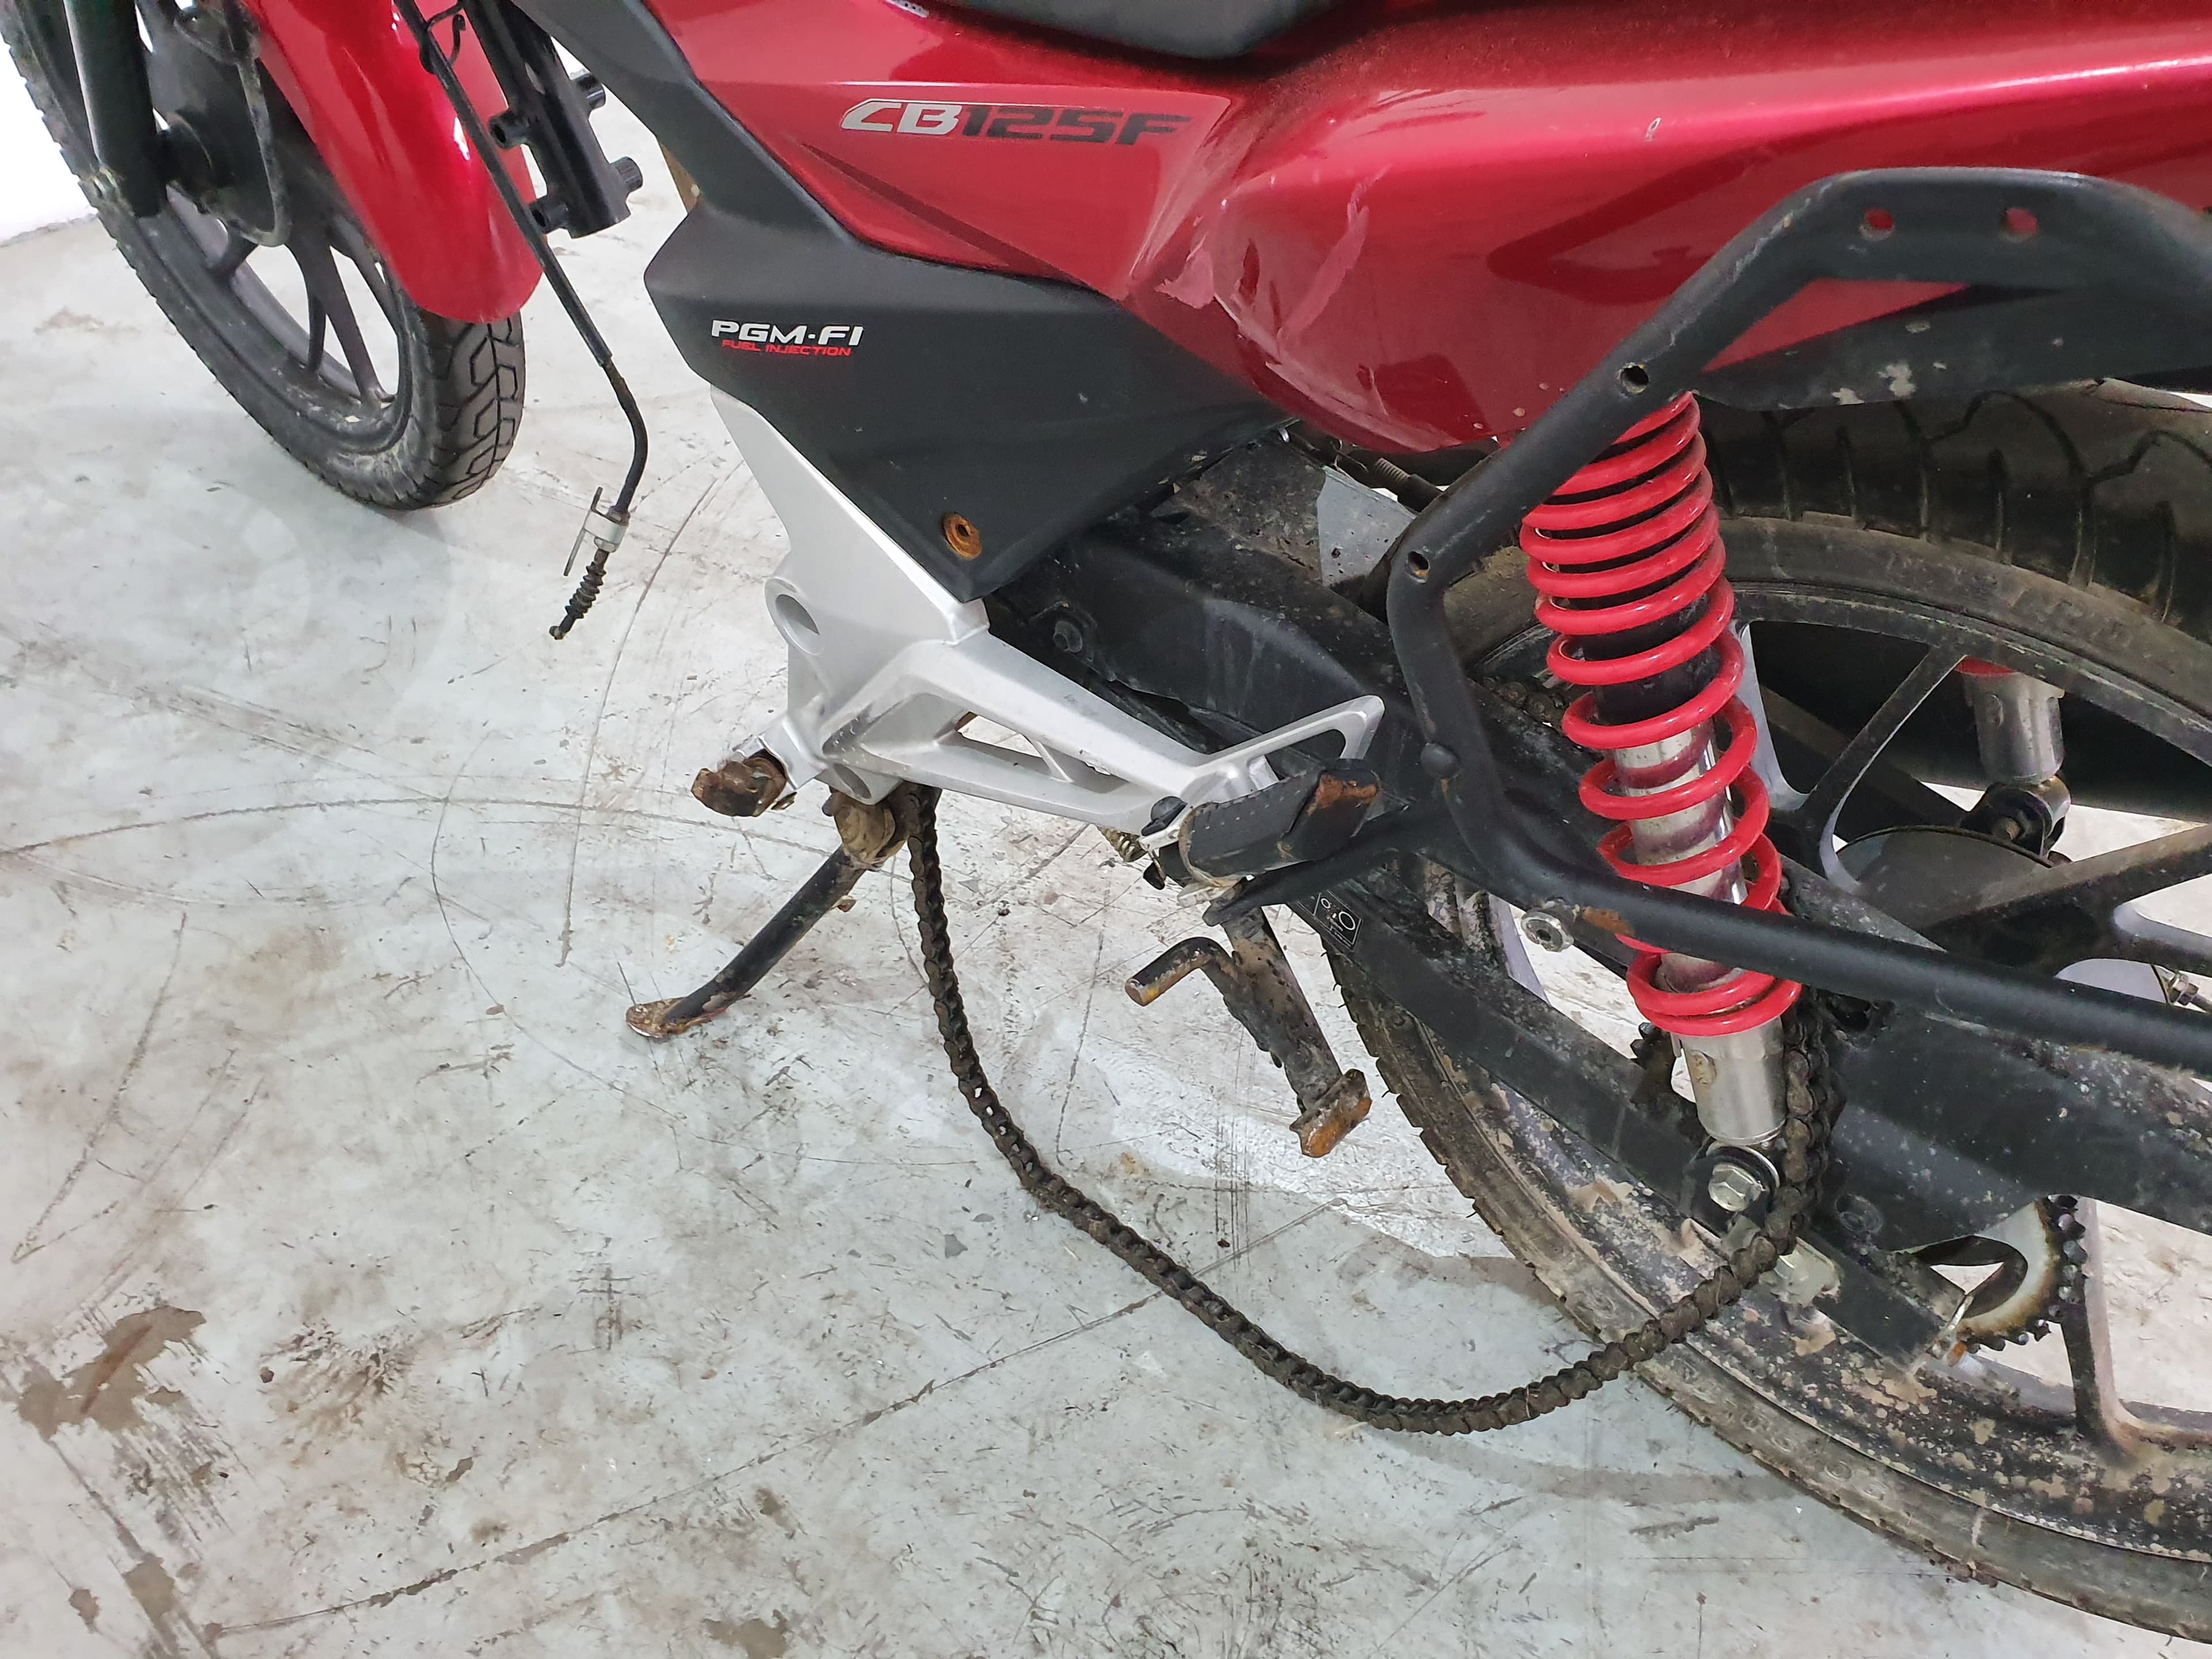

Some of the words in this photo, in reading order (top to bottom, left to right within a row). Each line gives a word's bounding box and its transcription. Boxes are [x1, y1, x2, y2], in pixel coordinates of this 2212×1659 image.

[840, 102, 1190, 145] CB125F
[722, 339, 762, 352] FUEL
[765, 344, 853, 357] INJECTION
